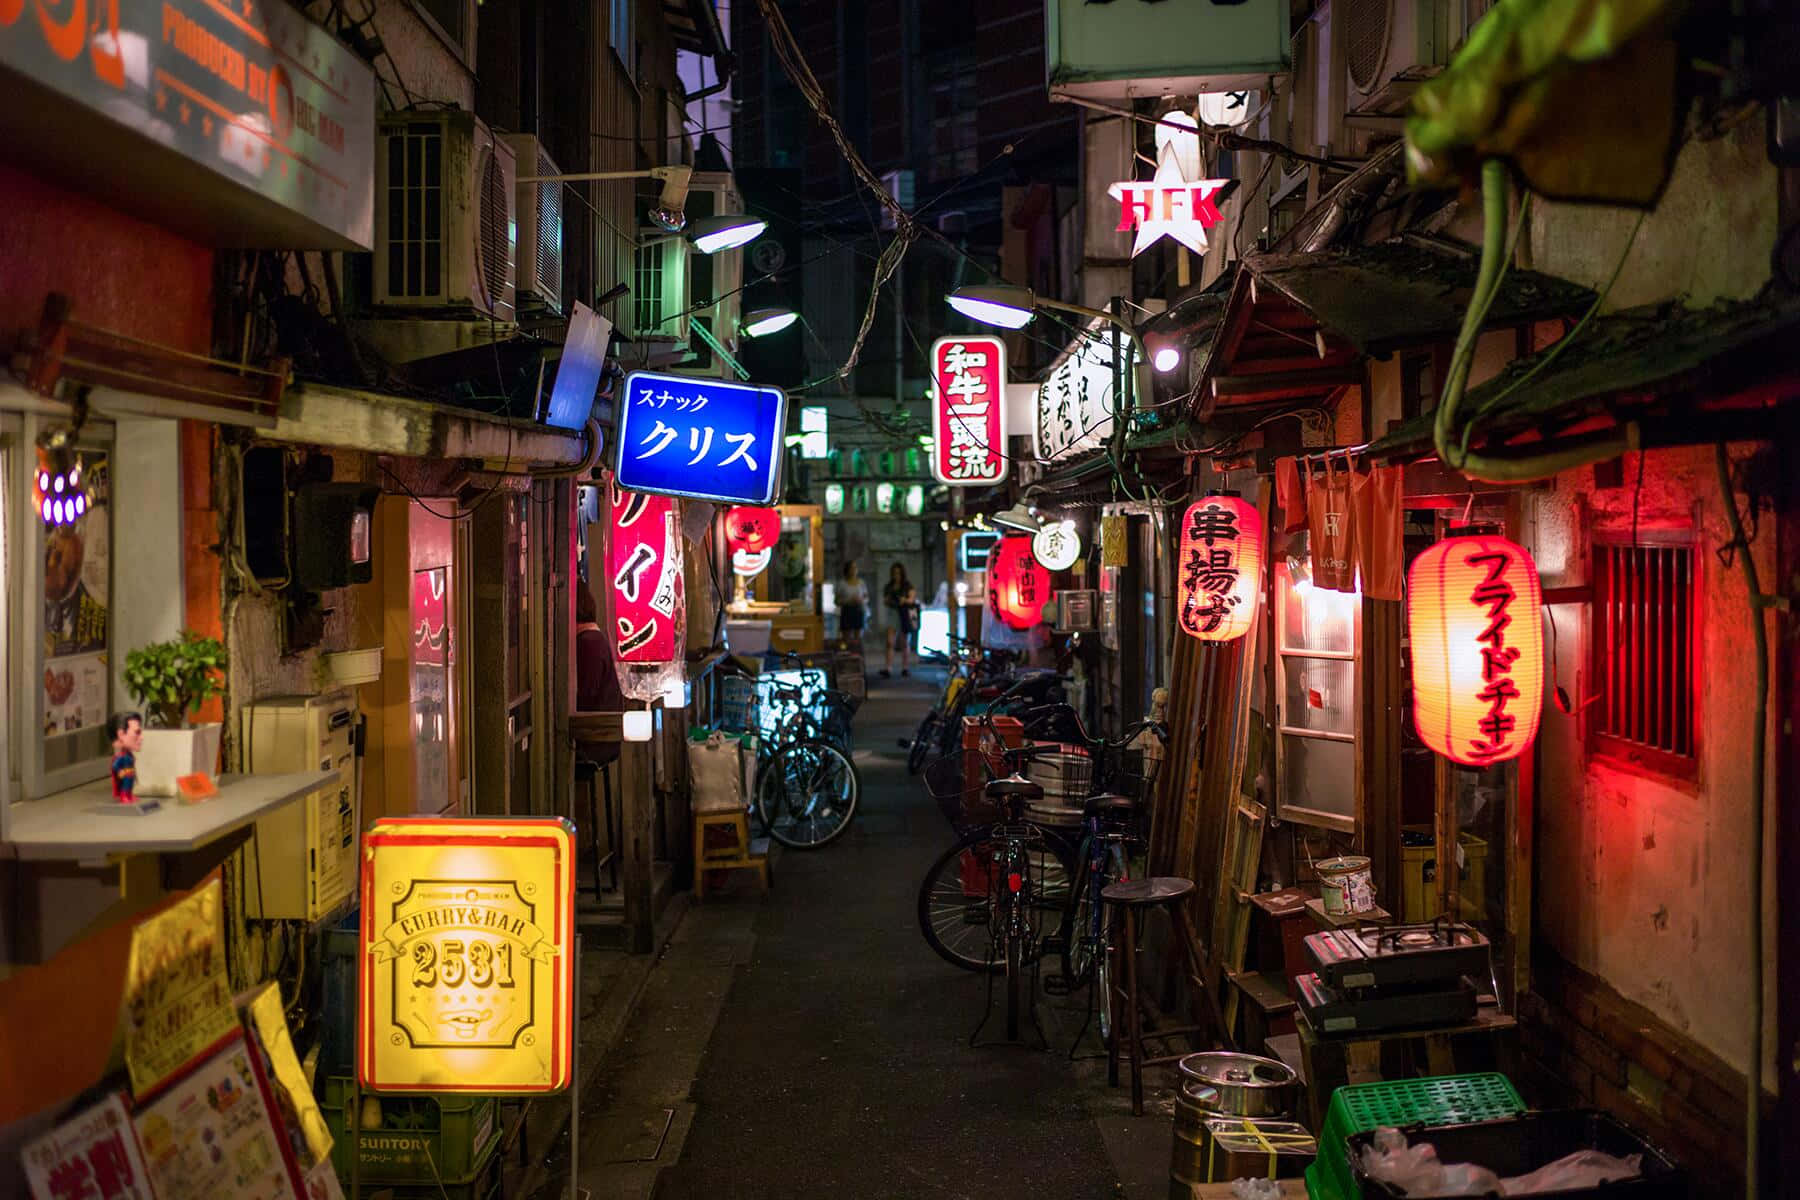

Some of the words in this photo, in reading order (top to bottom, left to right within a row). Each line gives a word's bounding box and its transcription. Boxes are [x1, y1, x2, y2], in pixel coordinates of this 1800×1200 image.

[1115, 188, 1226, 232] HFK
[636, 389, 709, 413] スナック
[943, 343, 997, 479] 和牛一頭流
[635, 420, 758, 472] クリス
[1183, 504, 1242, 633] 串揚げ
[1464, 552, 1521, 761] フライドチキン
[400, 907, 526, 937] CURRY&BAR
[412, 939, 515, 989] 2531
